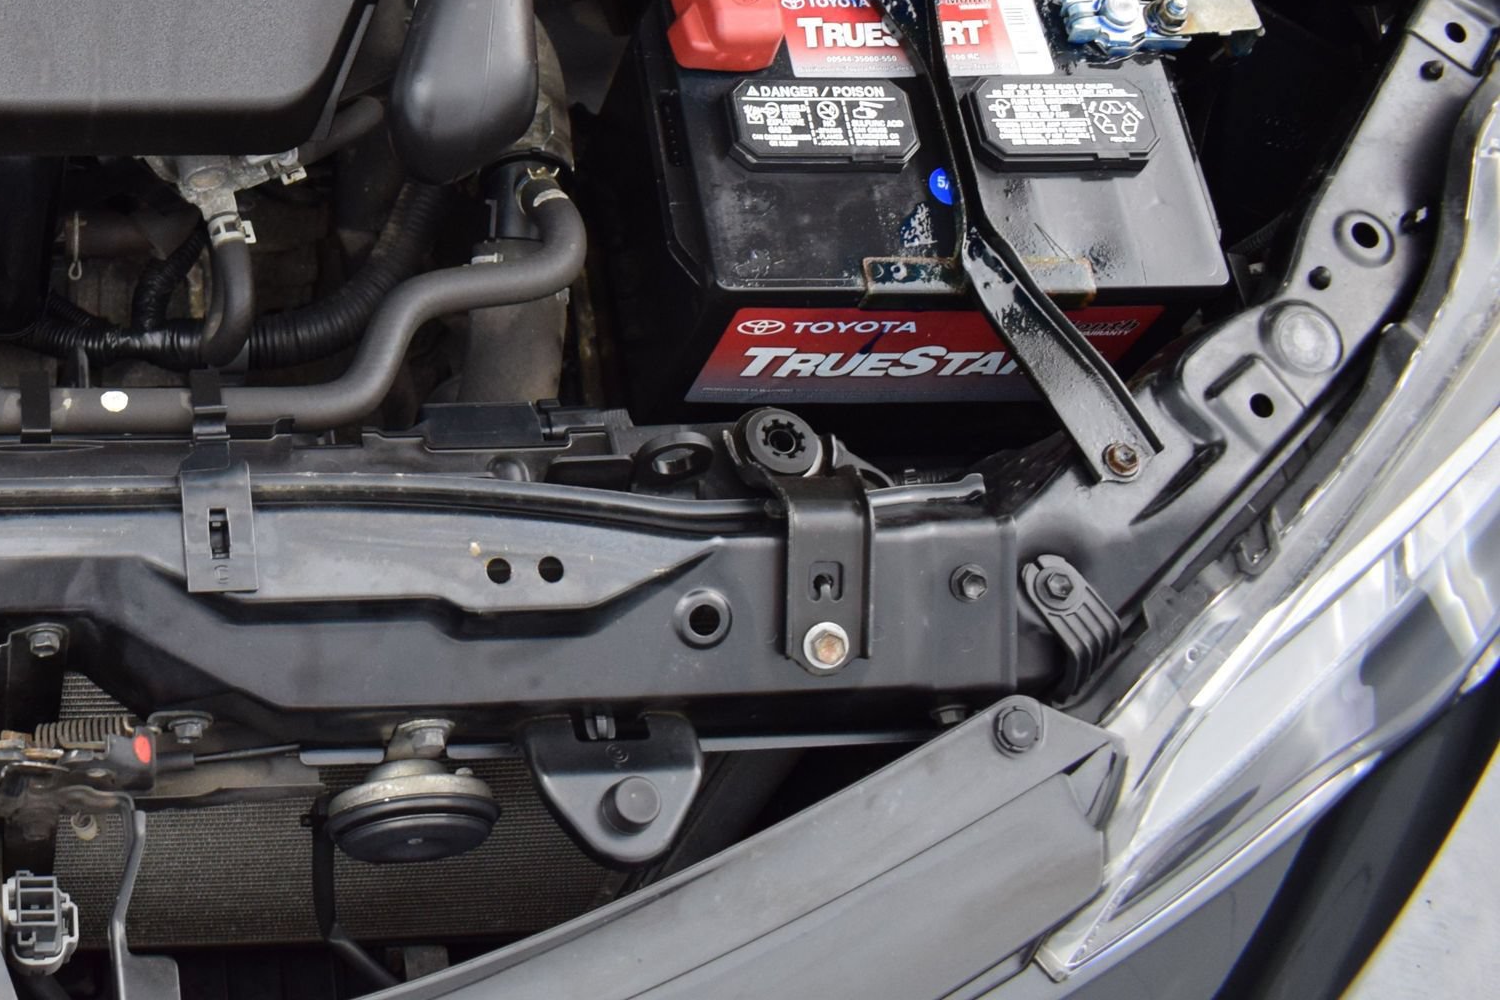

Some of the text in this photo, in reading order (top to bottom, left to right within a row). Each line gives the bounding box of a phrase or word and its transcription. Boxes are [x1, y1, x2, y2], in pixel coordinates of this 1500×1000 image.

[760, 86, 885, 98] DANGER / POISON
[792, 321, 917, 334] TOYOTA
